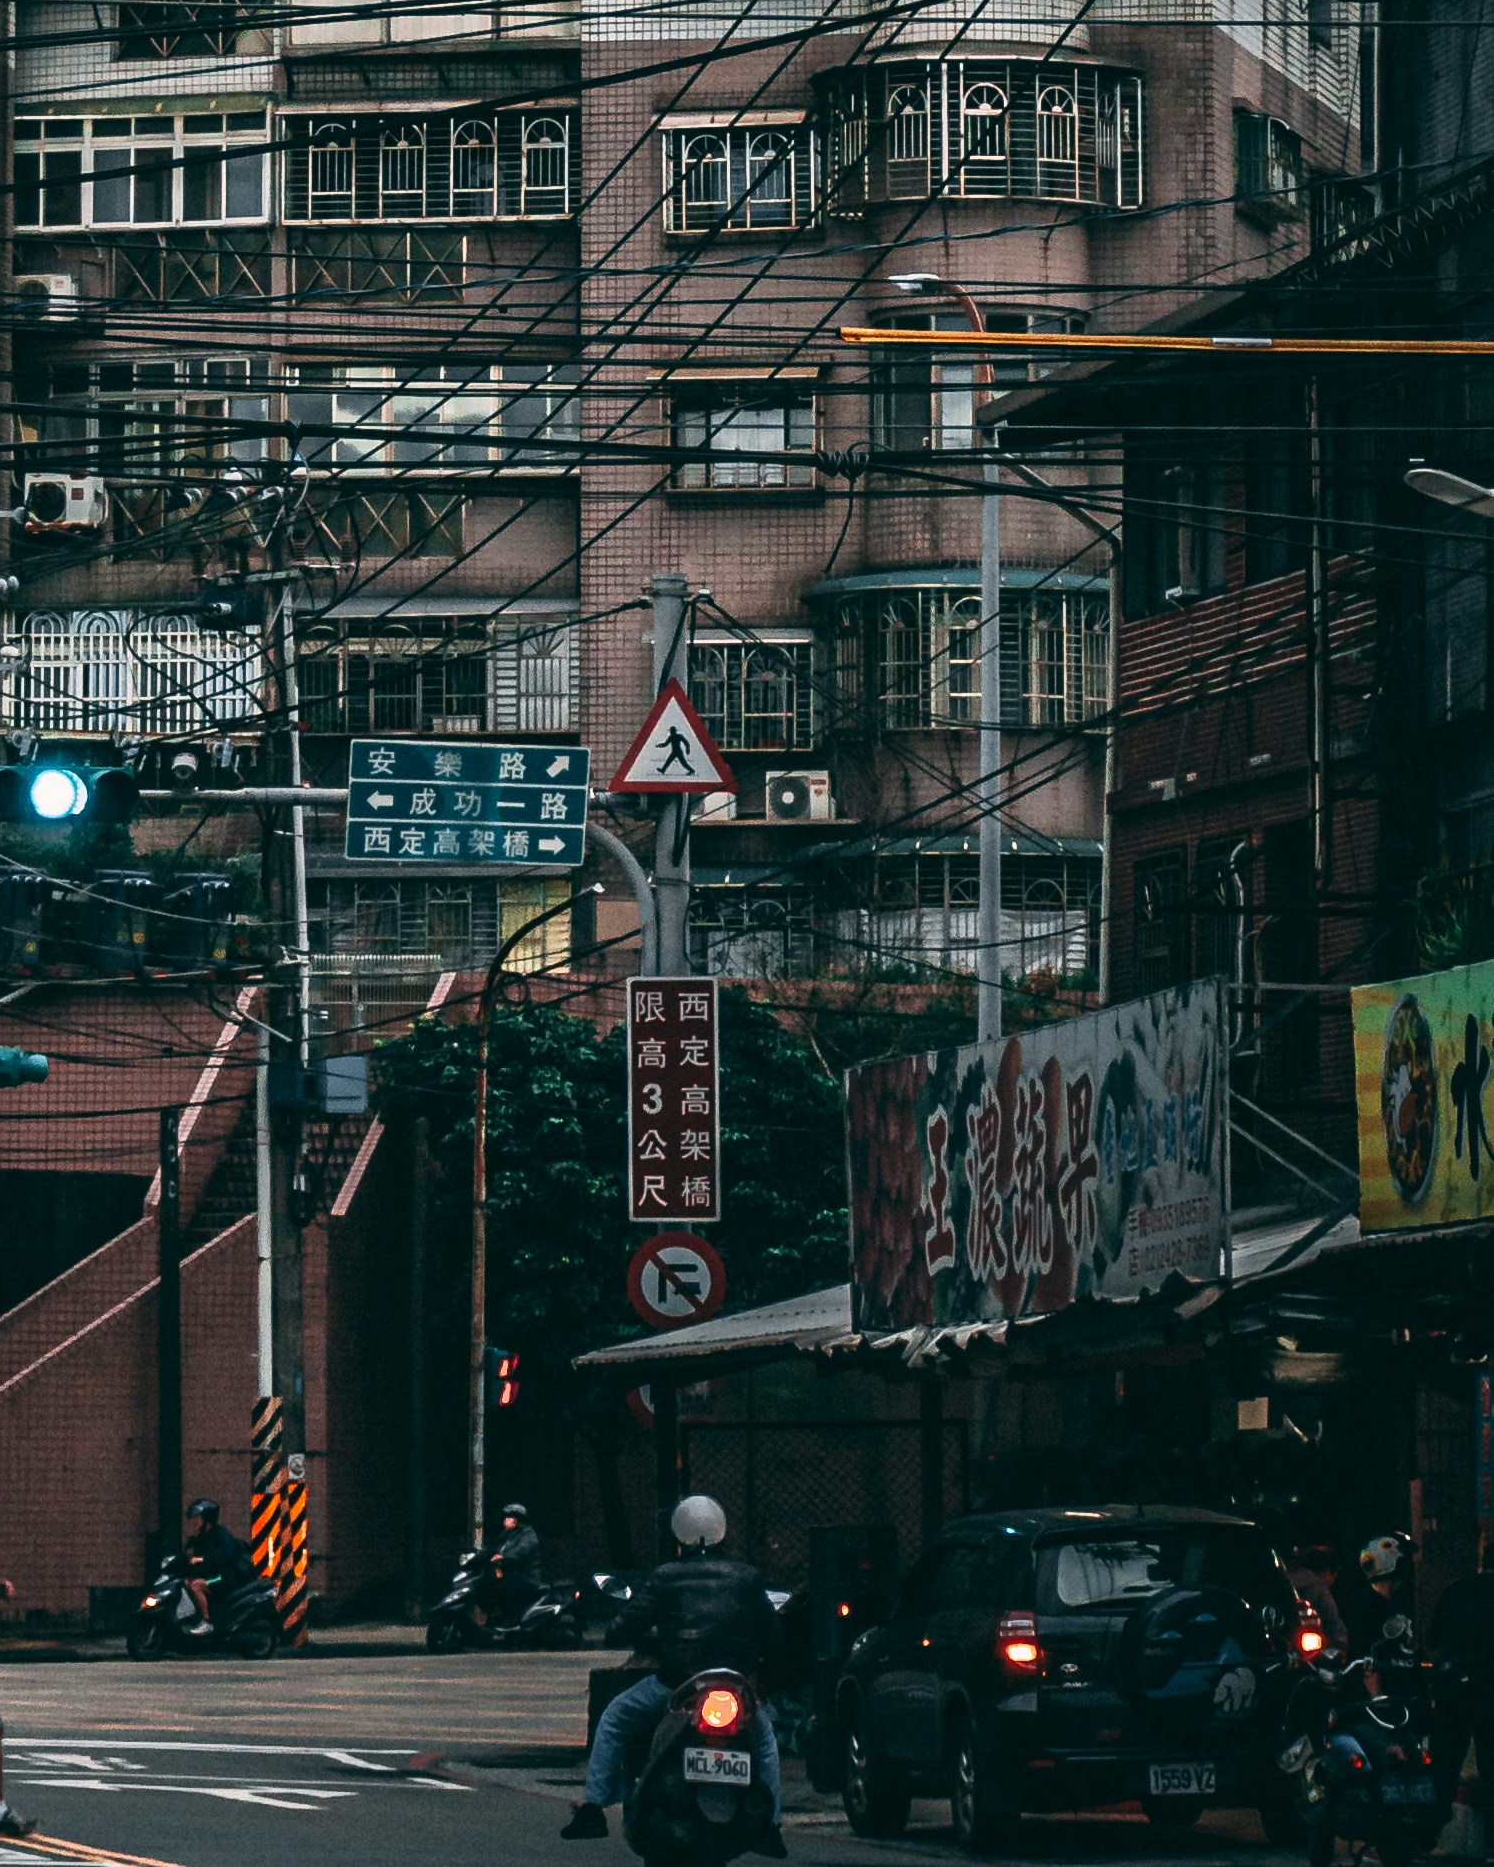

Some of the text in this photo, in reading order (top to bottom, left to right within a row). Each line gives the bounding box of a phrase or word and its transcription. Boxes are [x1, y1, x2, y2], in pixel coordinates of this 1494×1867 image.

[367, 746, 528, 781] 安樂路
[408, 788, 569, 821] 成功一路
[362, 825, 530, 859] 西定高架橋
[634, 990, 669, 1209] 限高3公尺
[677, 990, 712, 1209] 西定高架橋
